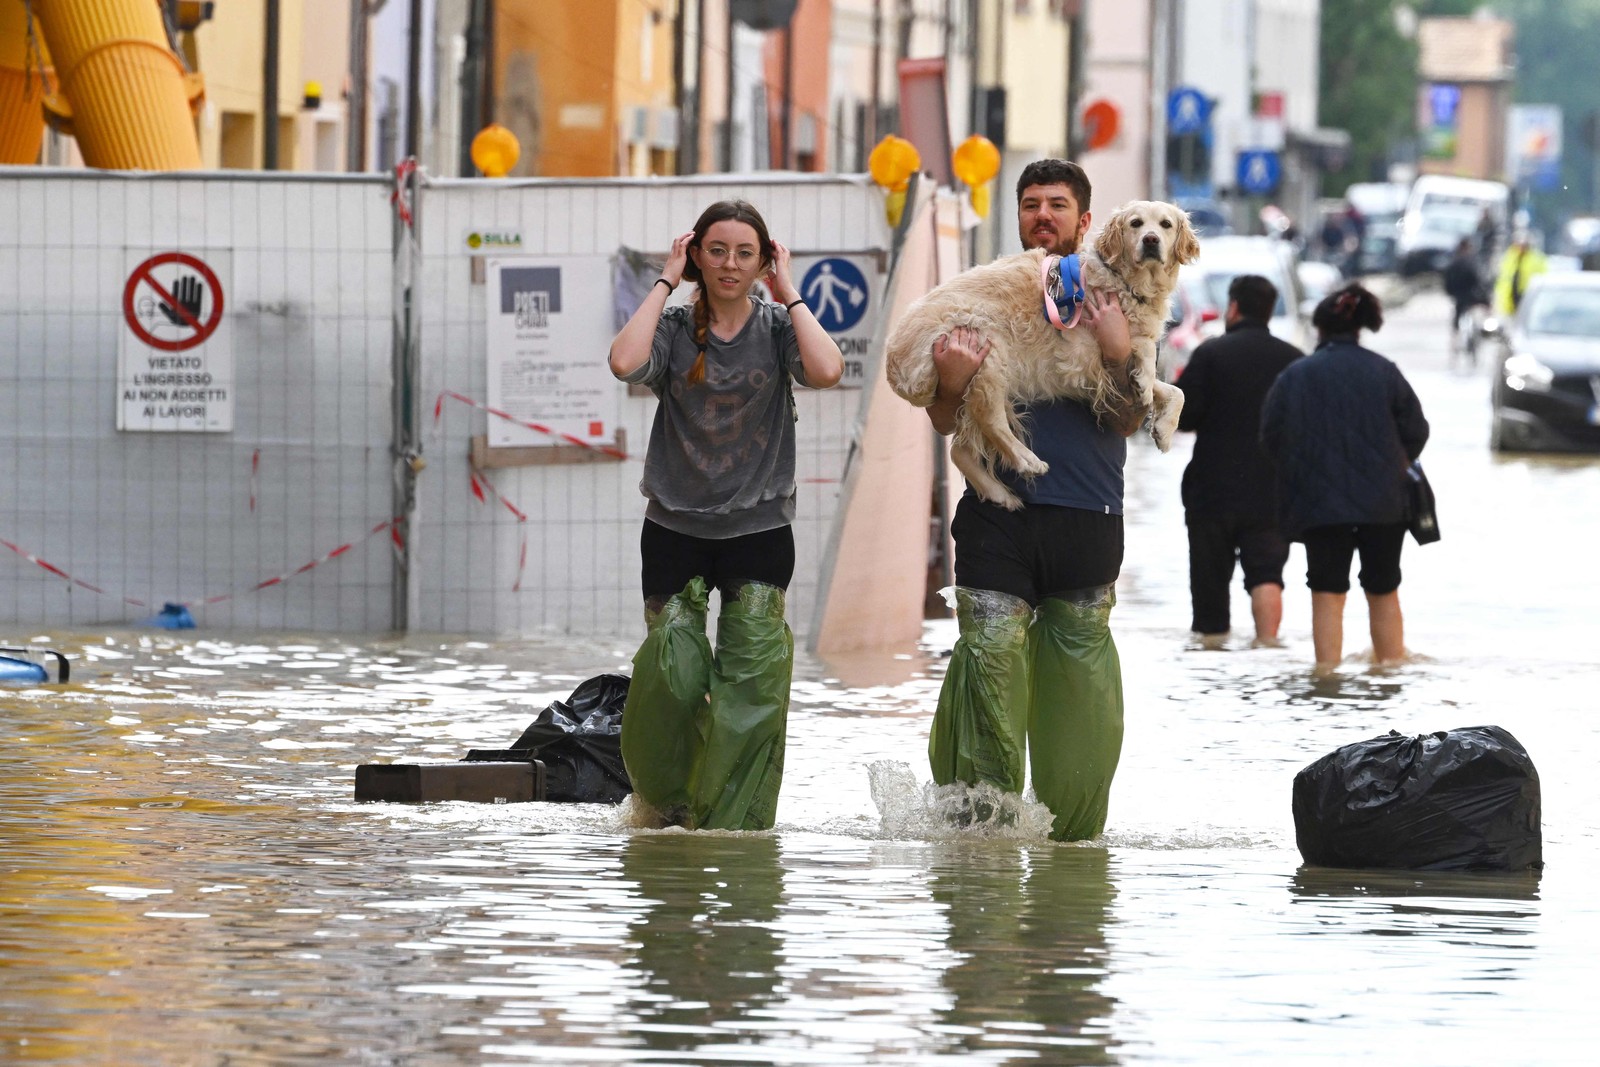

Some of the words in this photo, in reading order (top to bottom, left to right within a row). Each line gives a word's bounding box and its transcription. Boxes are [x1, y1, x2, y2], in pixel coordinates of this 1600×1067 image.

[839, 337, 868, 355] ONI
[148, 356, 203, 370] VIETATO
[133, 373, 213, 386] L'INGRESSO
[124, 389, 136, 401] AI
[139, 389, 167, 401] NON
[171, 389, 227, 402] ADDETTI
[143, 405, 155, 418] AI
[159, 405, 206, 418] LAVORI
